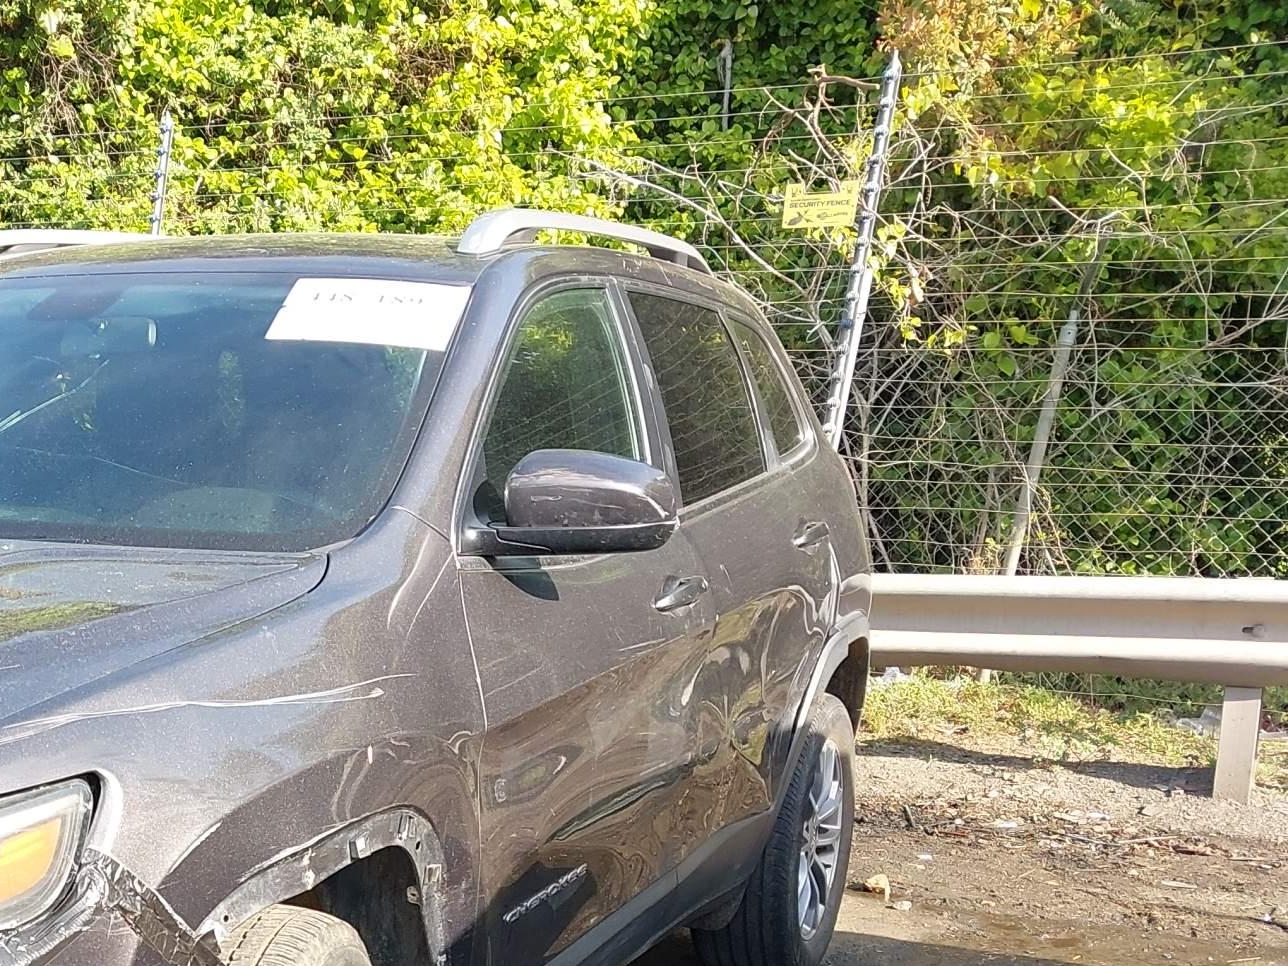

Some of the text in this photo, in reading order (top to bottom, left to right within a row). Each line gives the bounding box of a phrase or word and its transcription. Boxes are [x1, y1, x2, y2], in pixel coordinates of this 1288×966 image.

[789, 200, 825, 209] SECURITY
[826, 199, 851, 207] FENCE
[502, 862, 588, 923] CHEROKEE
